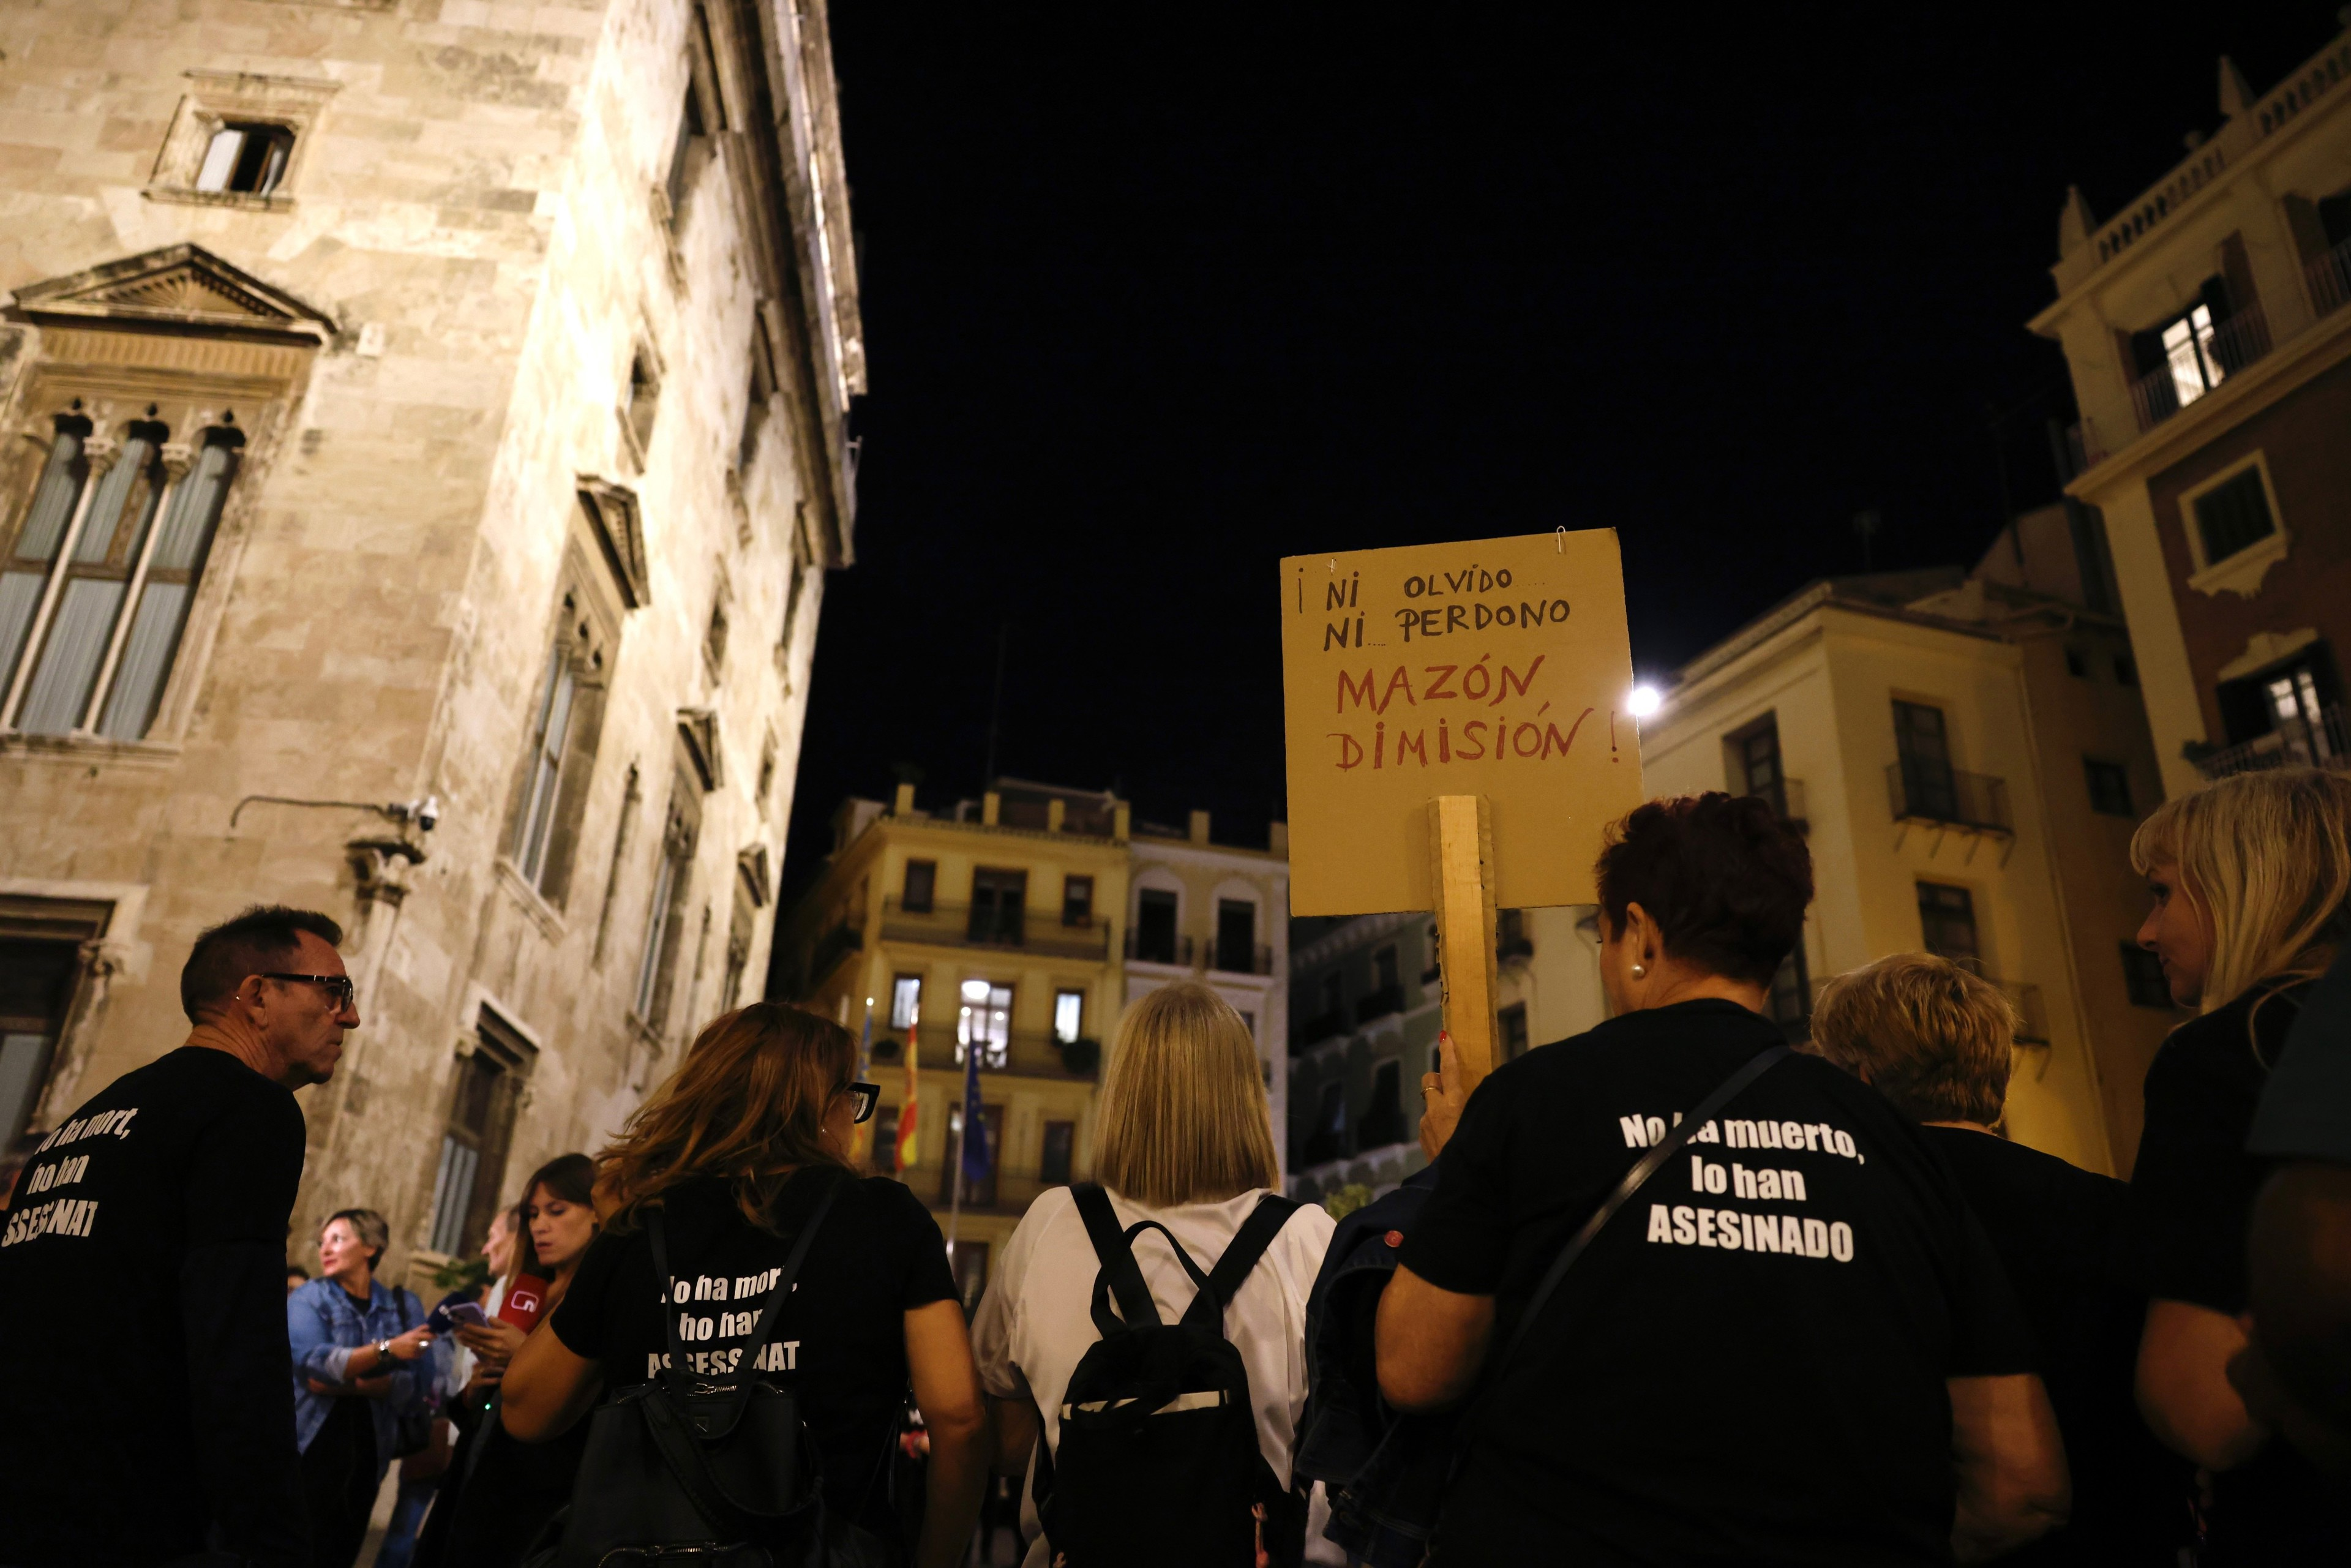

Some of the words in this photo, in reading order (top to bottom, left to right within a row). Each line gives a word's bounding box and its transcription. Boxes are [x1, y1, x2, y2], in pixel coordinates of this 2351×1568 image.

[1395, 599, 1570, 643] PERDONO
[1337, 653, 1545, 715] MAZÓN
[1619, 1113, 1667, 1149] No
[1723, 1119, 1865, 1166] muerto,
[26, 1163, 56, 1195] ho
[52, 1155, 90, 1188] han
[1690, 1155, 1728, 1195] lo
[1731, 1163, 1807, 1201] han
[1646, 1204, 1854, 1263] ASESINADO
[694, 1274, 729, 1301] ha
[733, 1265, 798, 1292] mor,
[679, 1312, 714, 1341] ho
